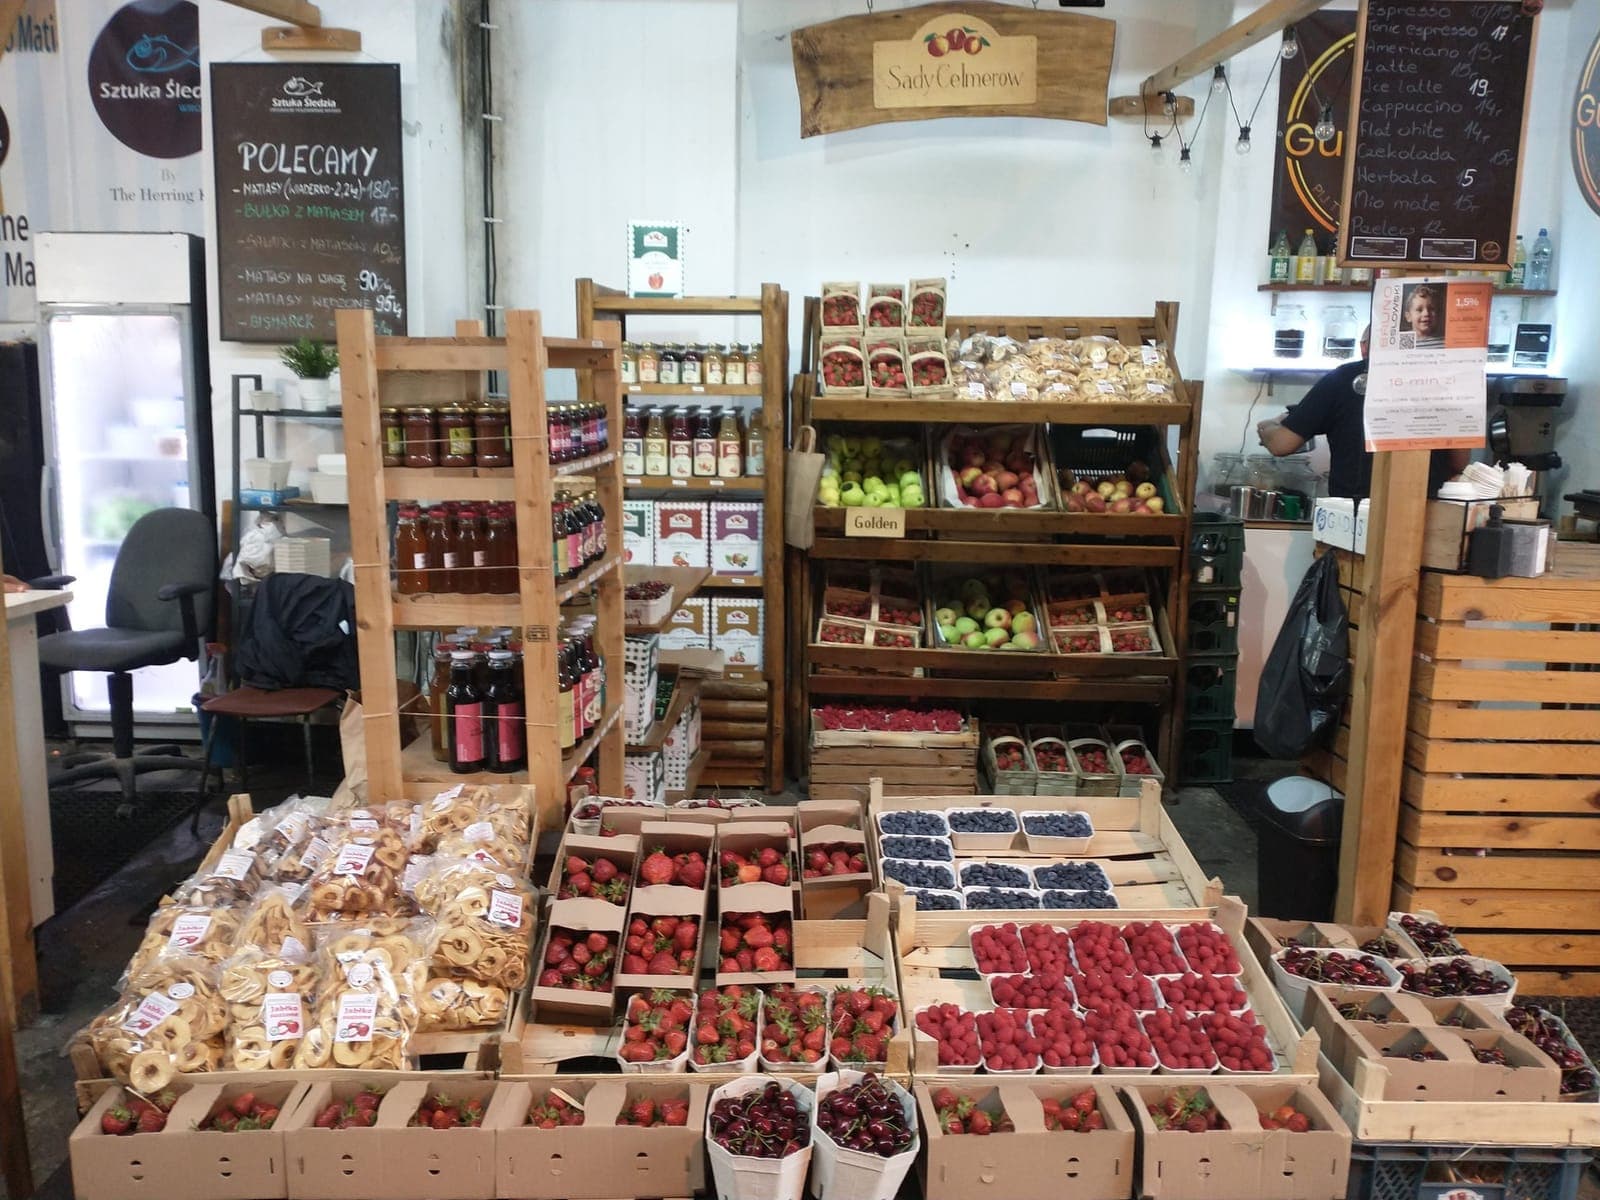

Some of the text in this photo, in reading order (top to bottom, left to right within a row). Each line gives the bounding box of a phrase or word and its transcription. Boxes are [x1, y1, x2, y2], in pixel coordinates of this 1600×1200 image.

[1406, 24, 1479, 41] espresso
[1366, 40, 1460, 58] Americano
[1365, 60, 1418, 74] Latte
[887, 63, 1024, 96] Sady Celmerow
[100, 82, 161, 99] Sztuka
[272, 95, 337, 107] Sztuka Śledzia
[1361, 100, 1464, 118] Cappuccino
[237, 142, 378, 176] POLECAMY
[1358, 143, 1456, 162] Czekolada
[161, 168, 176, 184] By
[1357, 166, 1437, 185] Herbata
[109, 188, 136, 201] The
[140, 187, 194, 203] Herring
[854, 515, 898, 529] Golden
